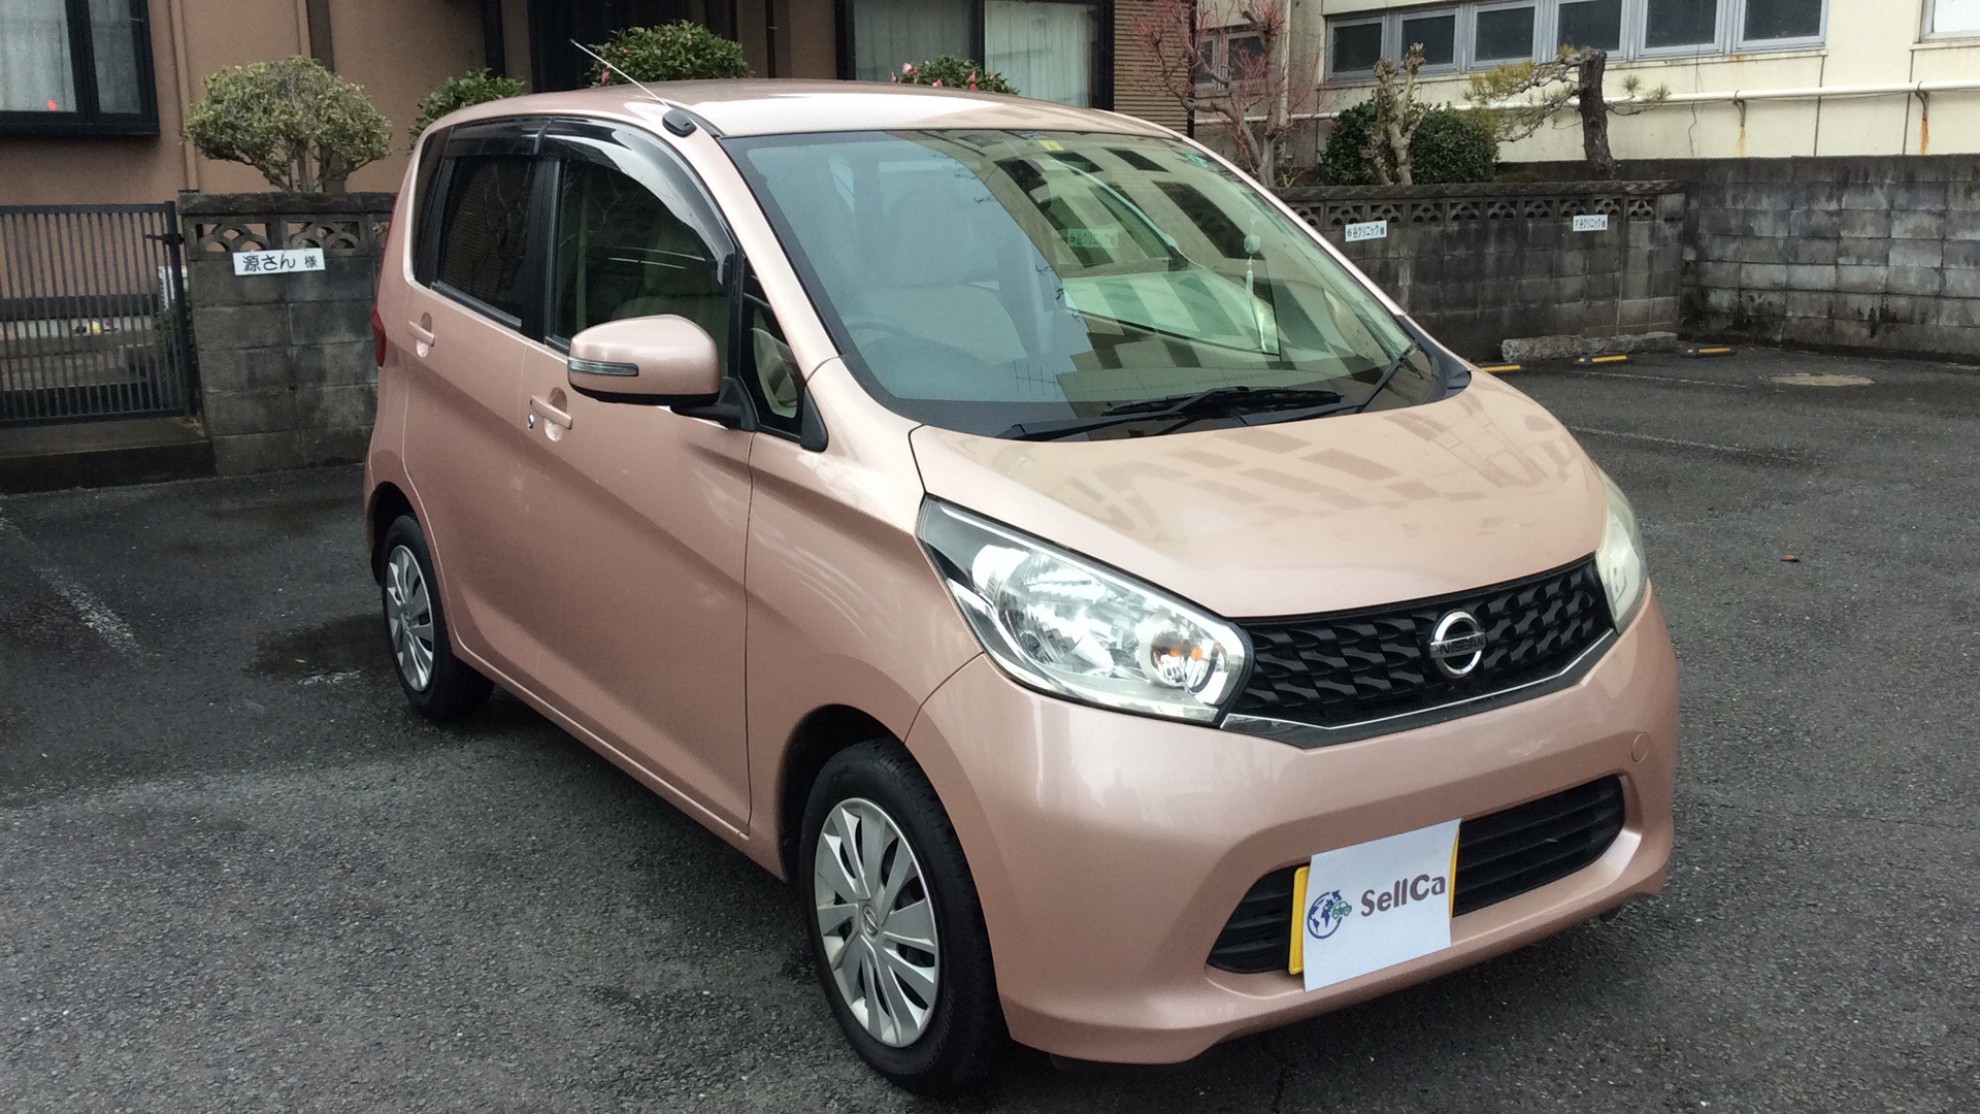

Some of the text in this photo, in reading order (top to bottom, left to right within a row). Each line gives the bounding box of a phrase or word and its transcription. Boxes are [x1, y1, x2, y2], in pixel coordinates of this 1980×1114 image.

[242, 253, 296, 272] 源さん
[1440, 636, 1484, 654] NISSAN
[1360, 873, 1446, 917] SellCa
